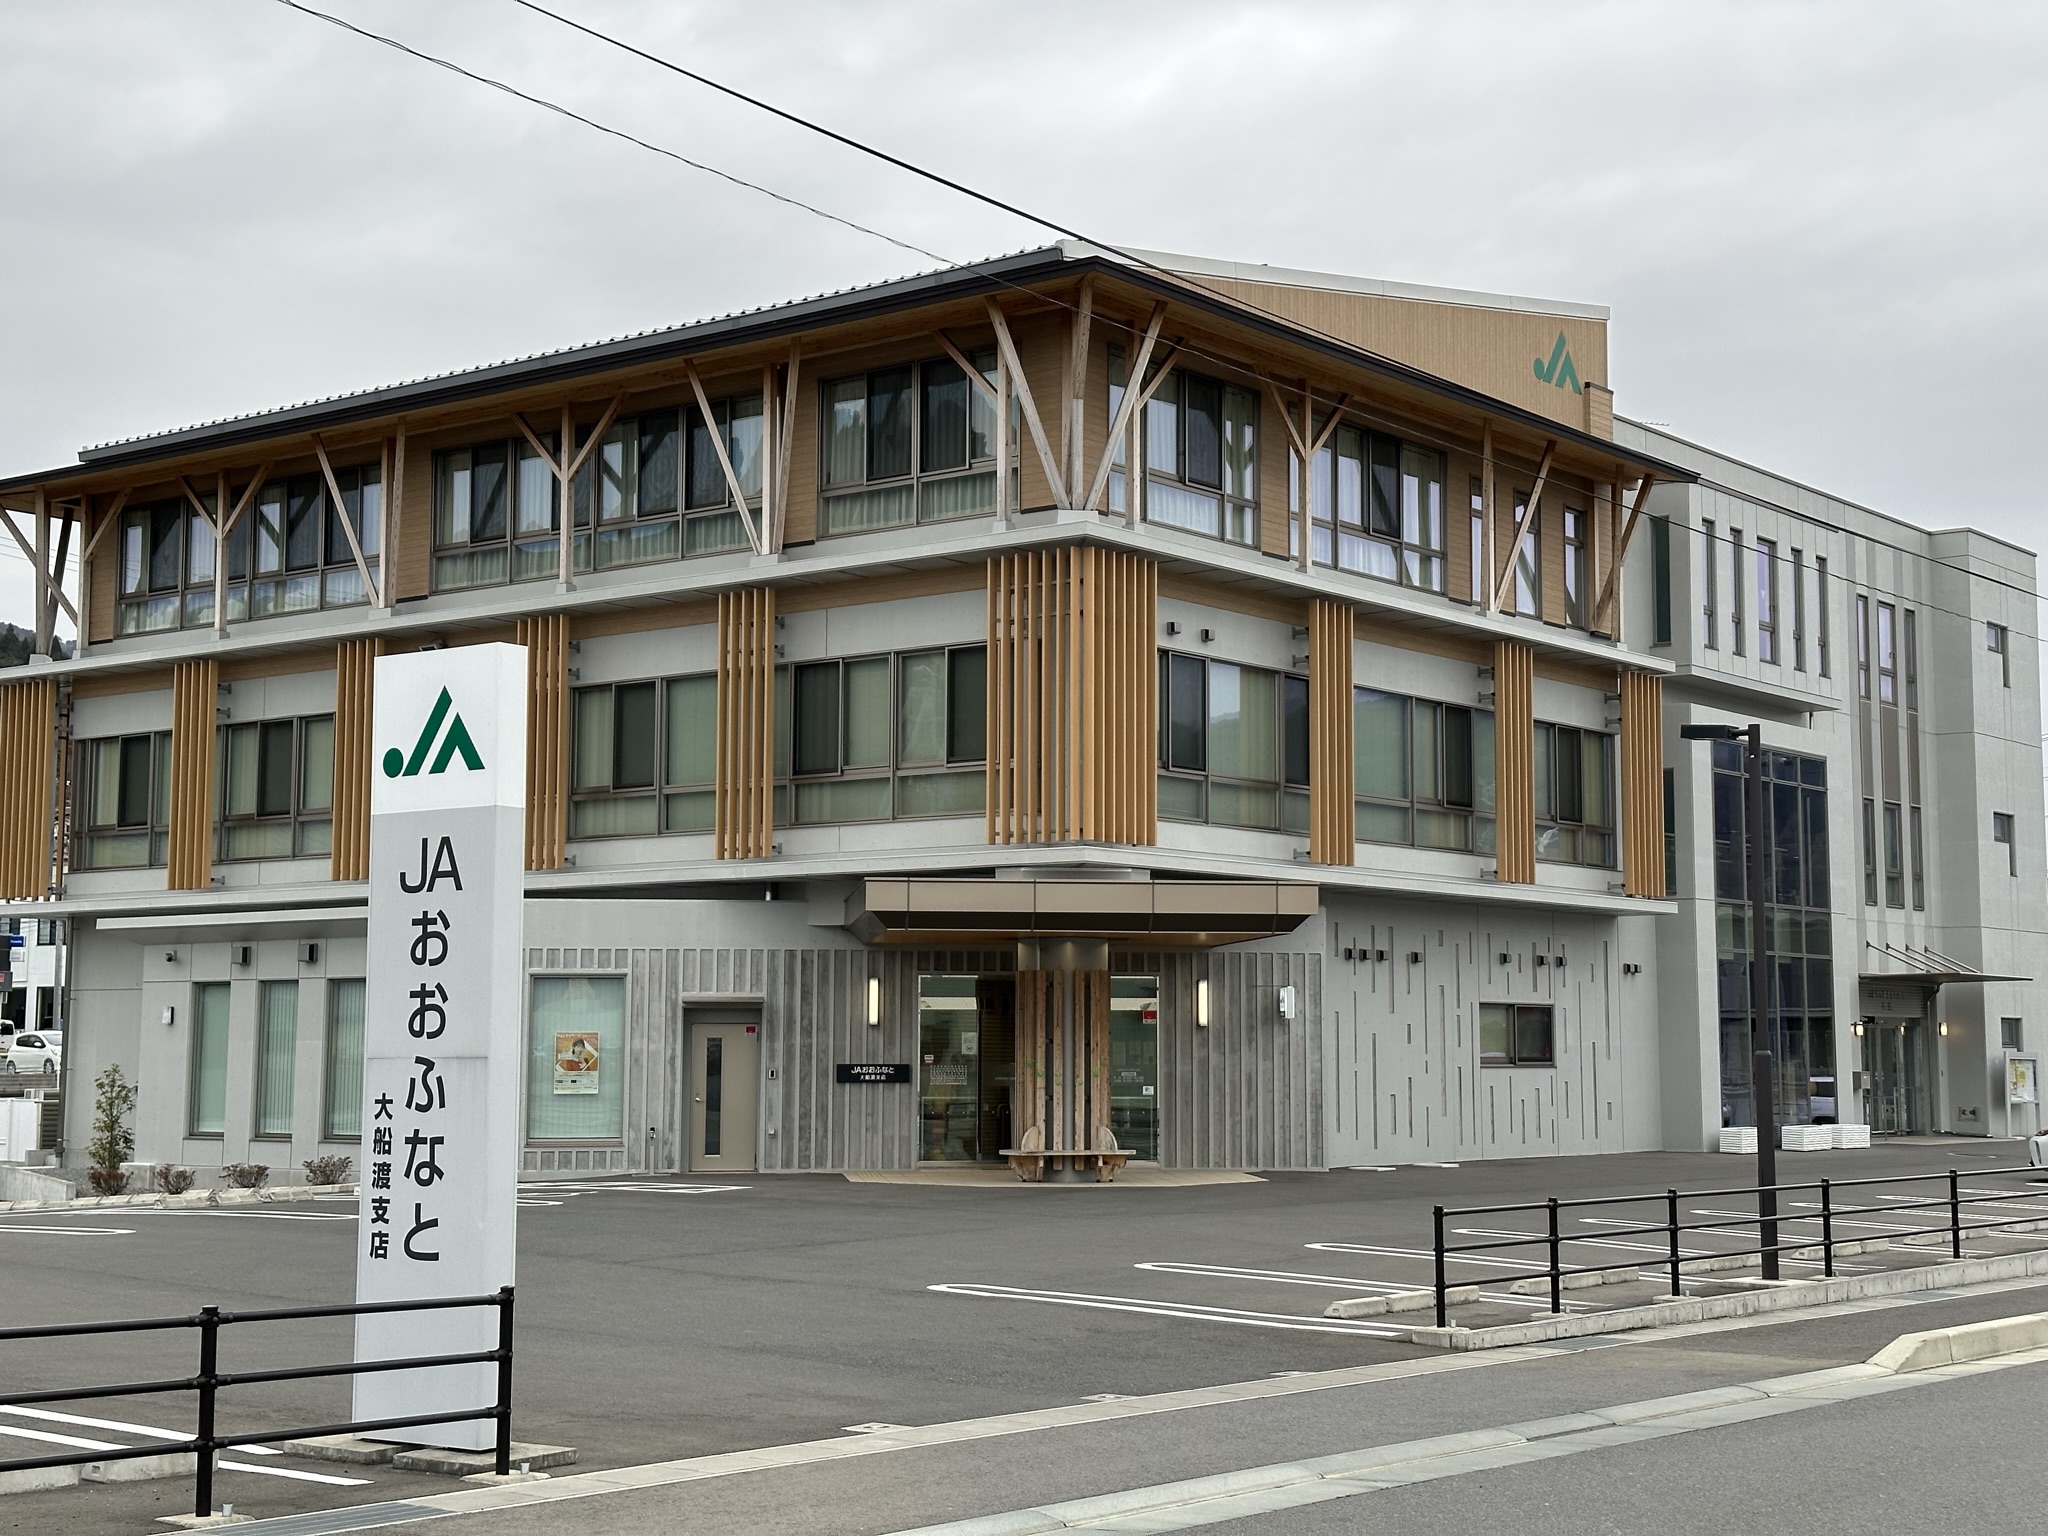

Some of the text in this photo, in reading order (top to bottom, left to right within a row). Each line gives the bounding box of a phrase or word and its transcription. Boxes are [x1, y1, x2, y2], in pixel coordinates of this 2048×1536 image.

[1533, 329, 1582, 395] JA
[383, 686, 485, 778] JA
[400, 836, 463, 1262] JAおおふなと
[851, 1066, 895, 1074] JAおおふなと
[370, 1092, 394, 1260] 大船渡支店
